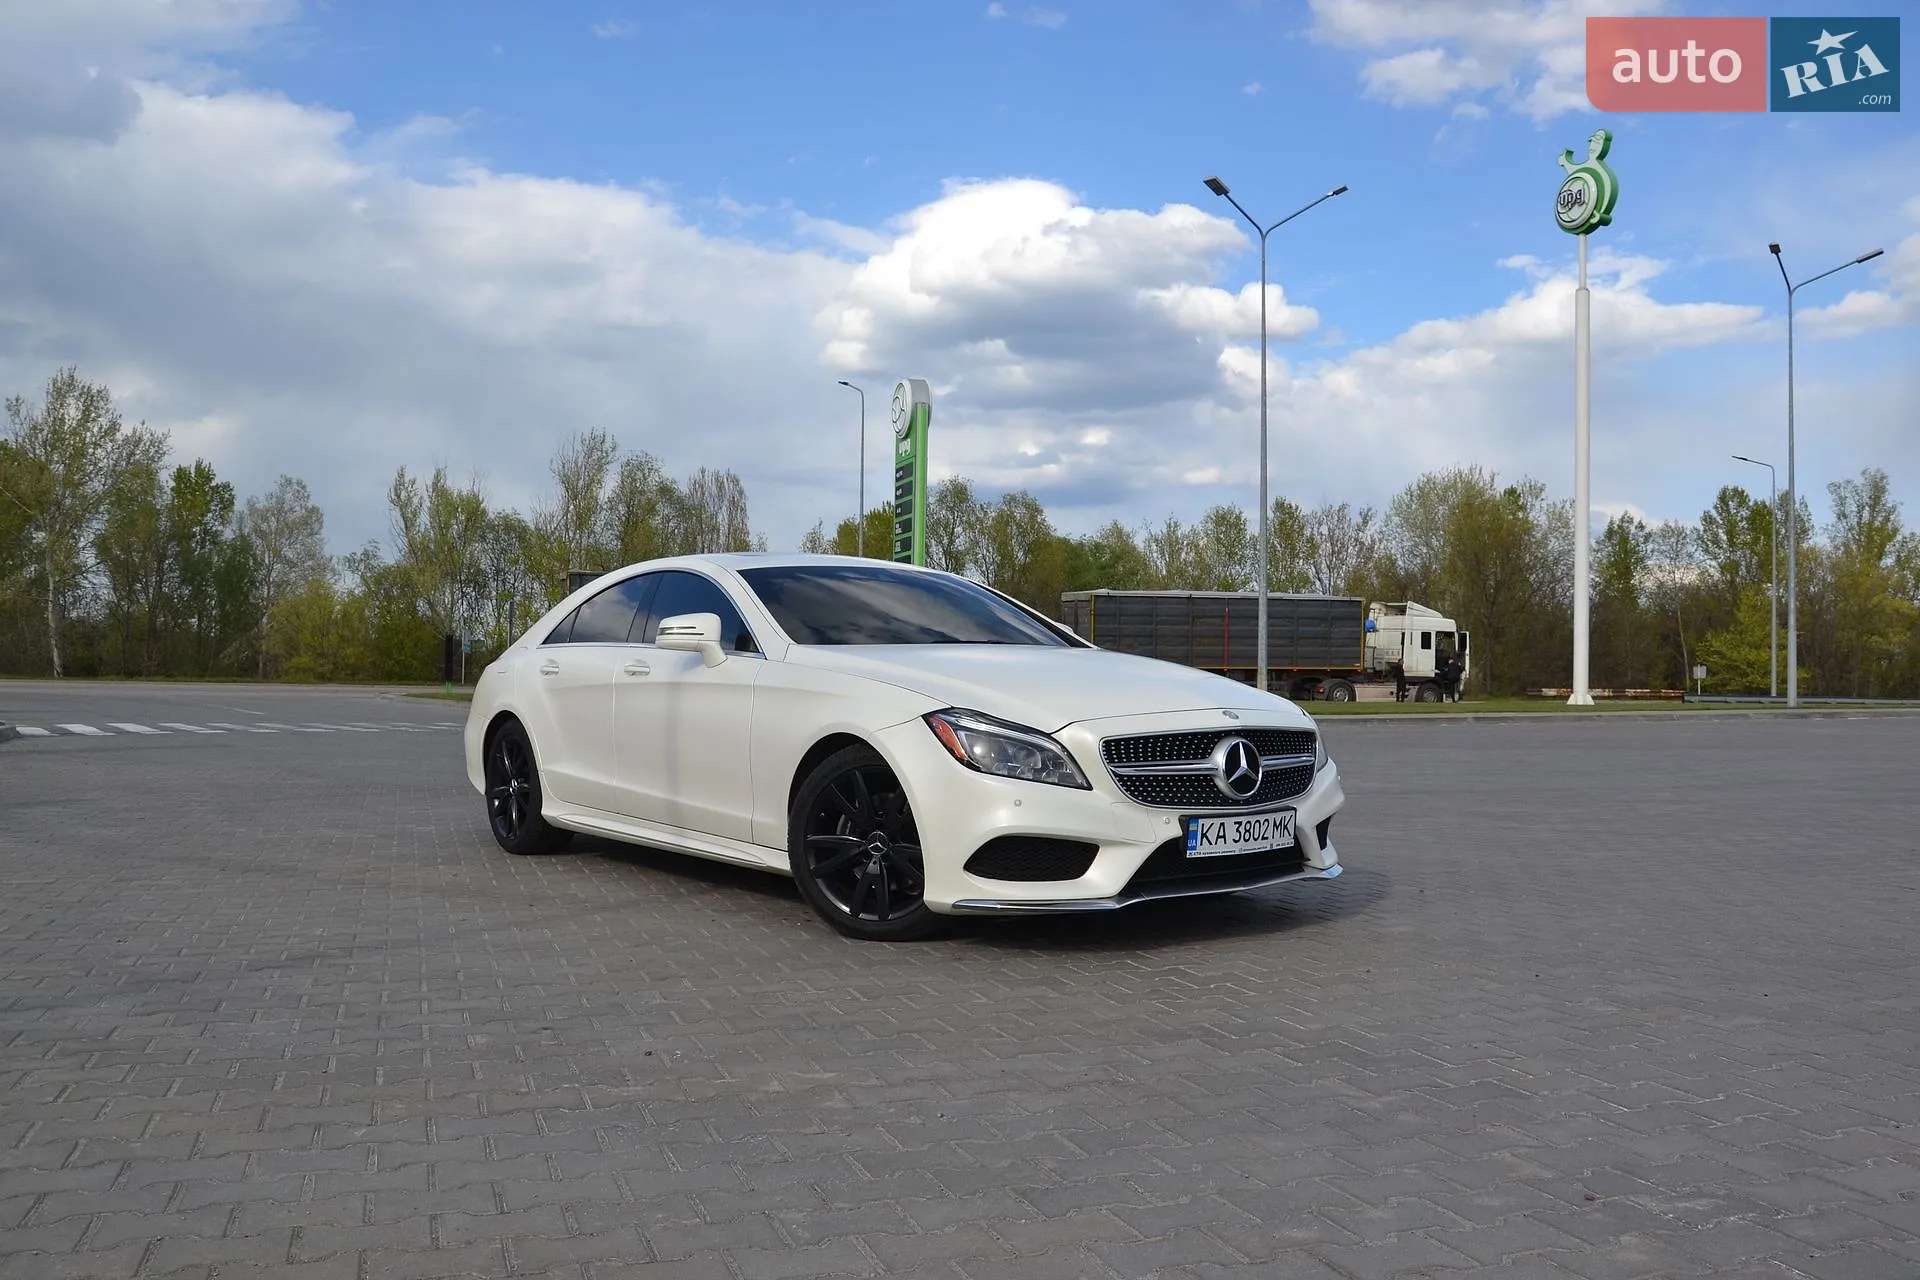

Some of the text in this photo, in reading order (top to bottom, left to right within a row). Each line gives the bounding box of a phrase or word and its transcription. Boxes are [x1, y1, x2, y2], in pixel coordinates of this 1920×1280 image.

[1200, 814, 1293, 846] KA 3802 MK
[1187, 839, 1197, 847] UA
